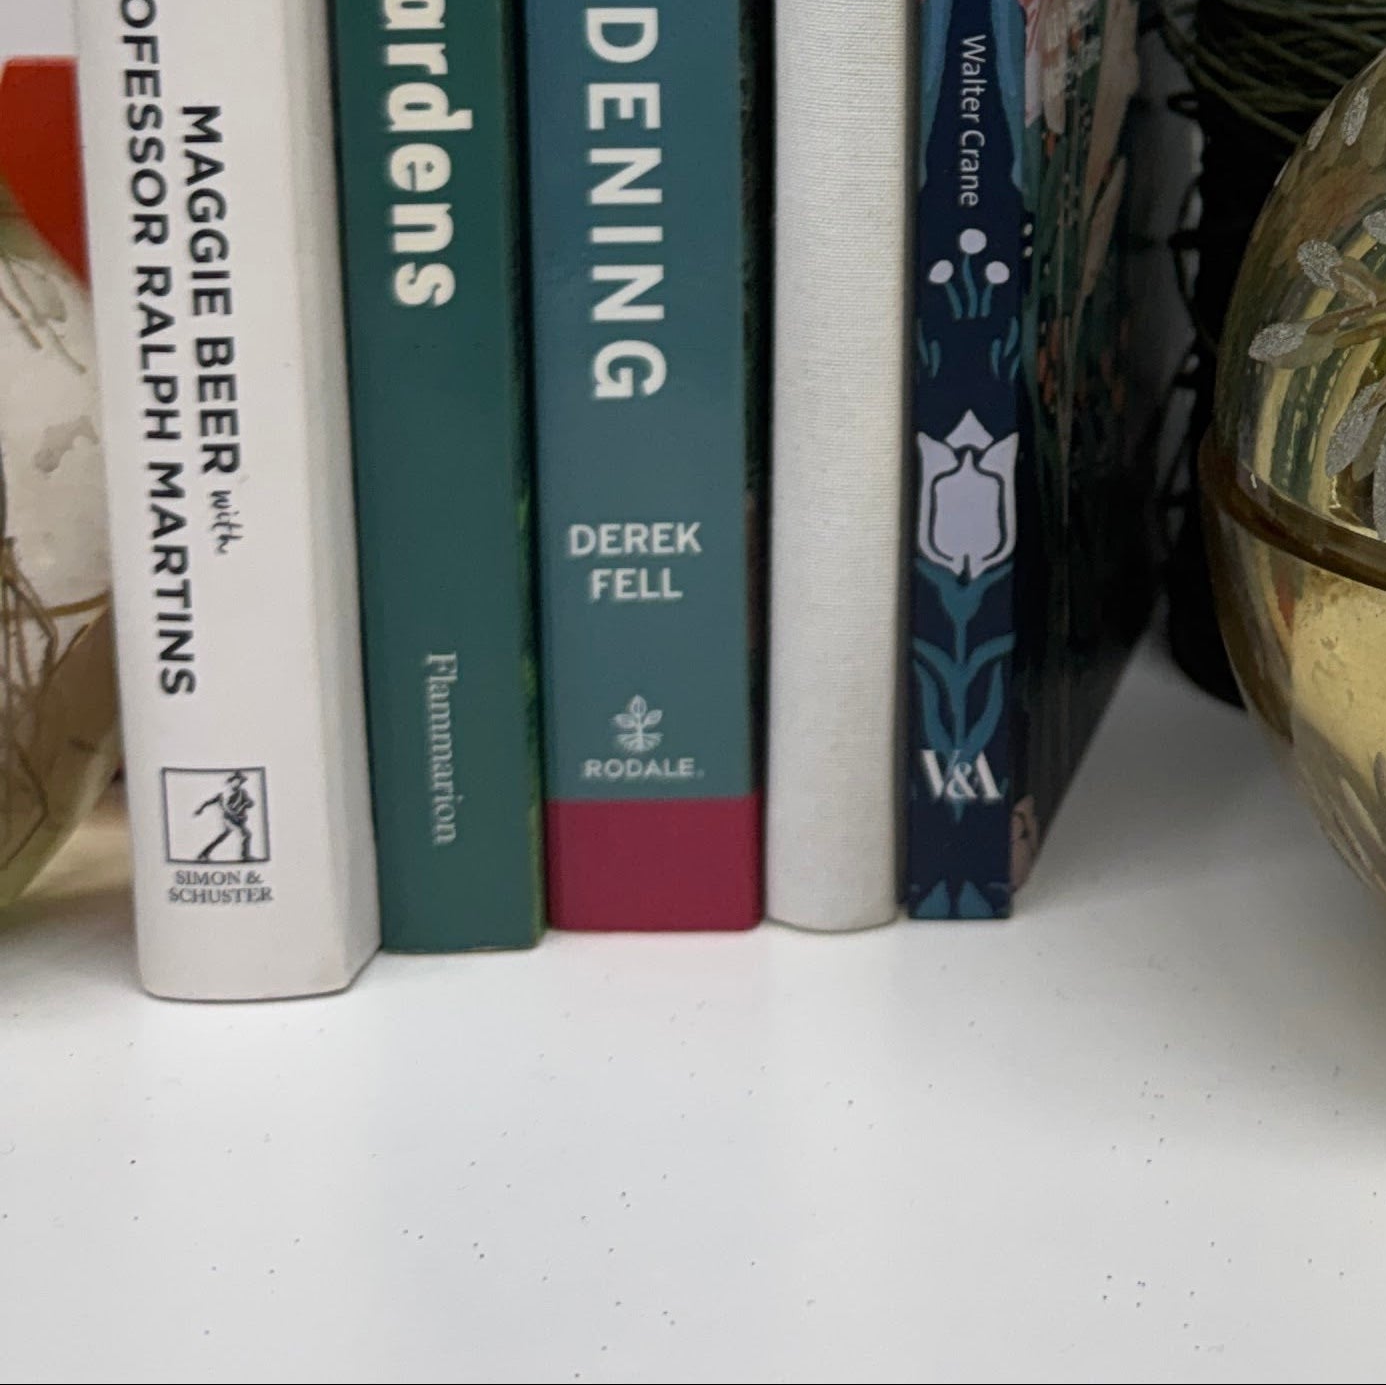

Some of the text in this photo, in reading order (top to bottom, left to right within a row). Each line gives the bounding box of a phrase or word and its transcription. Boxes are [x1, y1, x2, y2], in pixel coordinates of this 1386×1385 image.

[960, 33, 988, 207] Walter Crane
[134, 265, 182, 442] RALPH
[180, 105, 244, 556] MAGGIE BEER with
[146, 461, 197, 697] MARTINS
[568, 521, 703, 556] DEREK
[589, 567, 684, 601] FELL
[426, 651, 464, 846] Flammarion
[922, 749, 1002, 800] V&A
[167, 886, 274, 905] SCHUSTER
[174, 870, 264, 886] SIMON &
